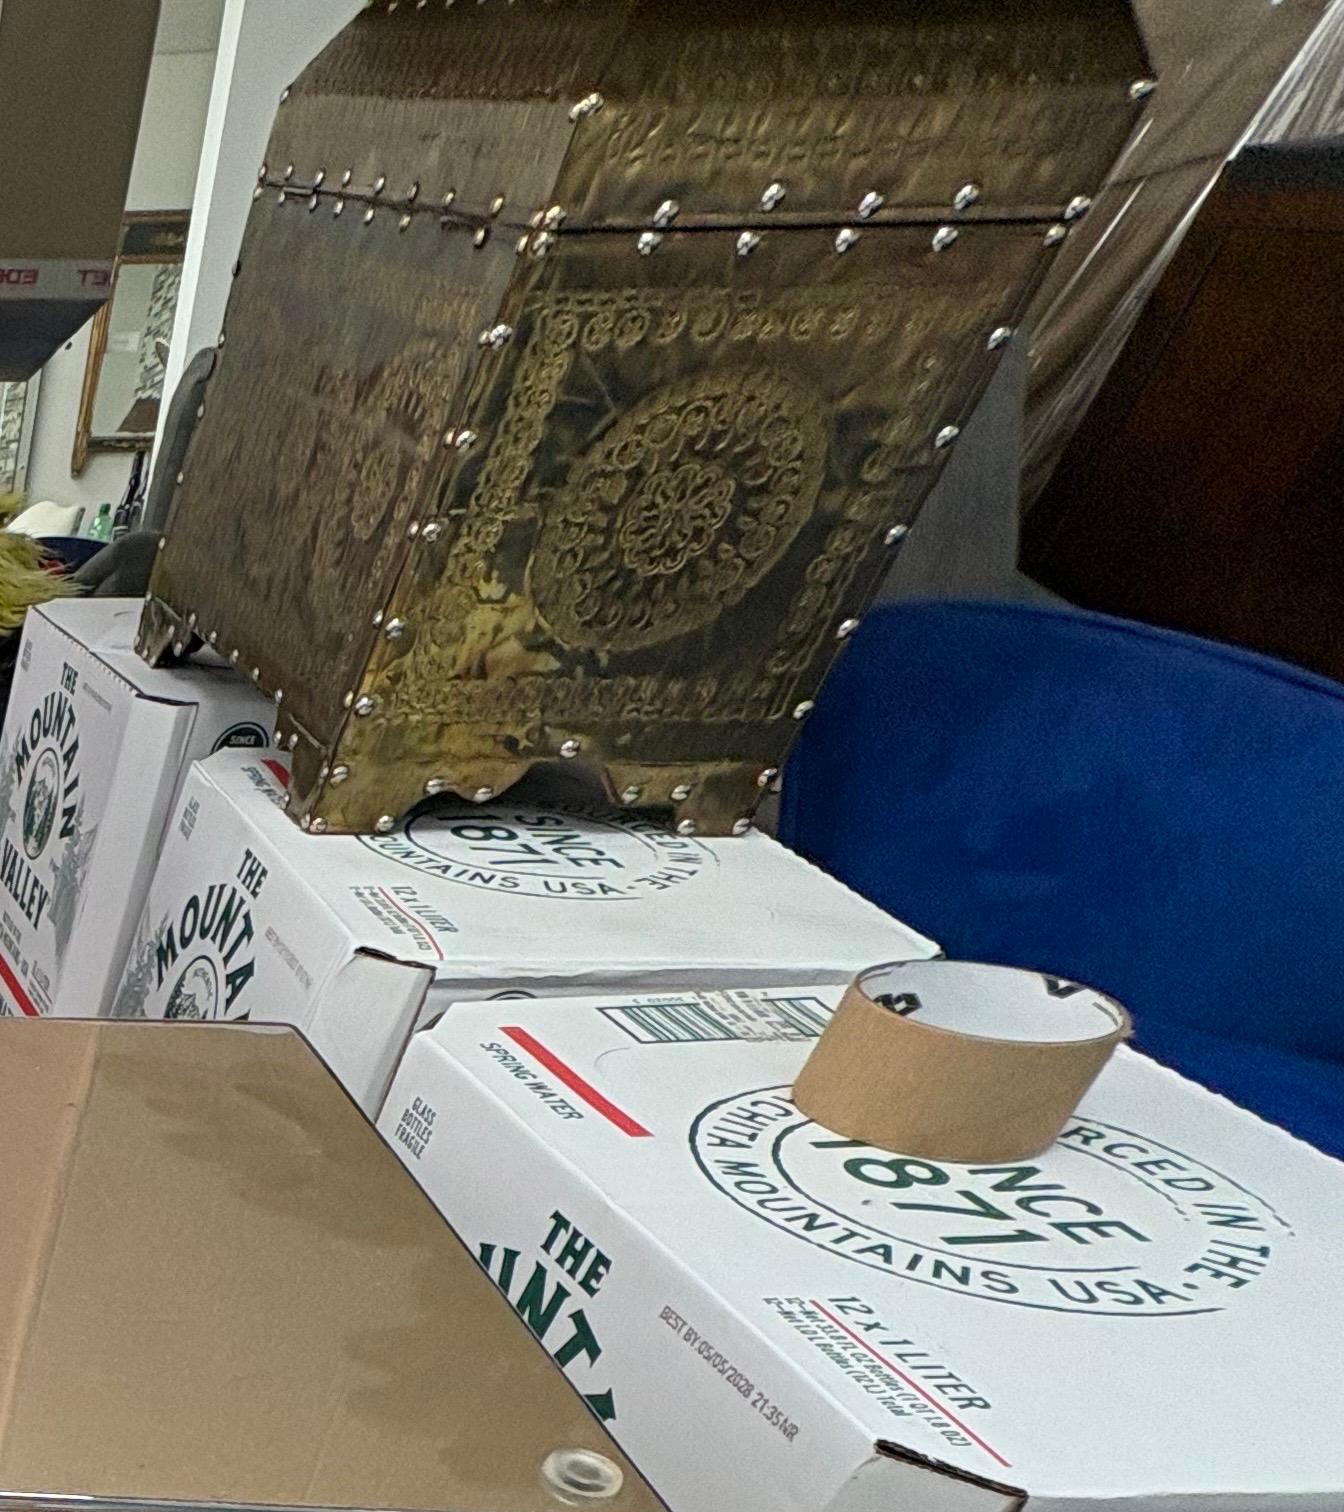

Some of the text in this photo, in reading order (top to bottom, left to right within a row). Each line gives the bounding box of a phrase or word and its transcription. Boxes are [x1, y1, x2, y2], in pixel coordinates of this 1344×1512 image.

[60, 661, 79, 696] THE
[15, 691, 80, 839] MOUNTAIN
[229, 735, 256, 745] SINCE
[369, 834, 621, 896] OUNTAINS USA
[438, 813, 560, 866] 1871
[514, 814, 625, 870] SINCE
[0, 838, 48, 931] VALLEY
[236, 848, 268, 899] THE
[634, 865, 698, 890] THE
[157, 884, 255, 1020] MOUNTA
[480, 1042, 584, 1120] SPRING WATER
[401, 1108, 433, 1145] BOTTLES
[411, 1096, 437, 1126] GLASS
[707, 1095, 795, 1149] CHITA
[394, 1123, 426, 1160] FRAGILE
[714, 1158, 1020, 1296] MOUNTAINS
[1059, 1125, 1271, 1291] RCED IN THE
[540, 1209, 613, 1298] THE
[659, 1305, 688, 1337] BEST
[828, 1296, 874, 1315] 12
[895, 1352, 992, 1410] LITER
